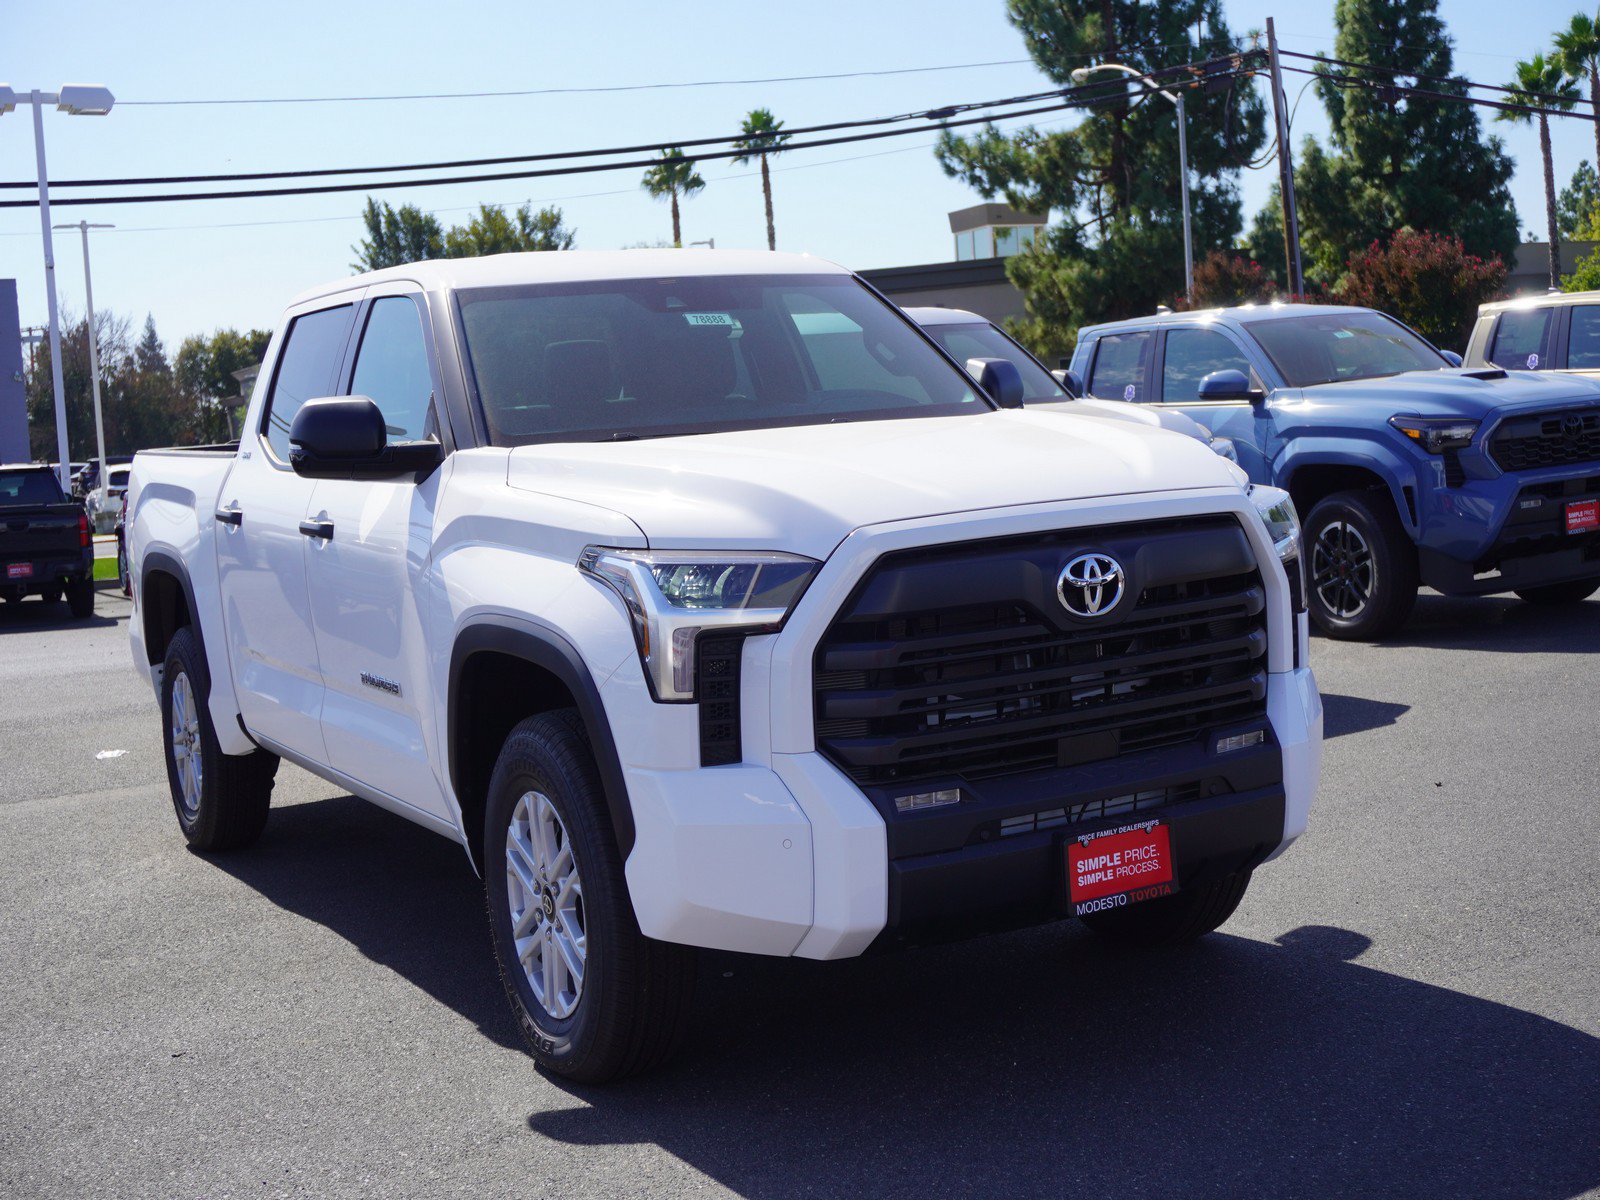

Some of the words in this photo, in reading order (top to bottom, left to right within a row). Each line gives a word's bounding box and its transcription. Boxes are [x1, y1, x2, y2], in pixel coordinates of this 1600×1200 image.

[692, 315, 726, 324] 78888
[1077, 834, 1095, 842] PRICE
[1096, 828, 1118, 838] FAMILY
[1118, 819, 1160, 833] DEALERSHIPS
[1077, 852, 1122, 873] SIMPLE
[1124, 844, 1160, 863] PRICE.
[1077, 869, 1114, 887] SIMPLE
[1116, 859, 1161, 878] PROCESS.
[1076, 894, 1127, 916] MODESTO
[1130, 885, 1172, 903] TOYOTA
